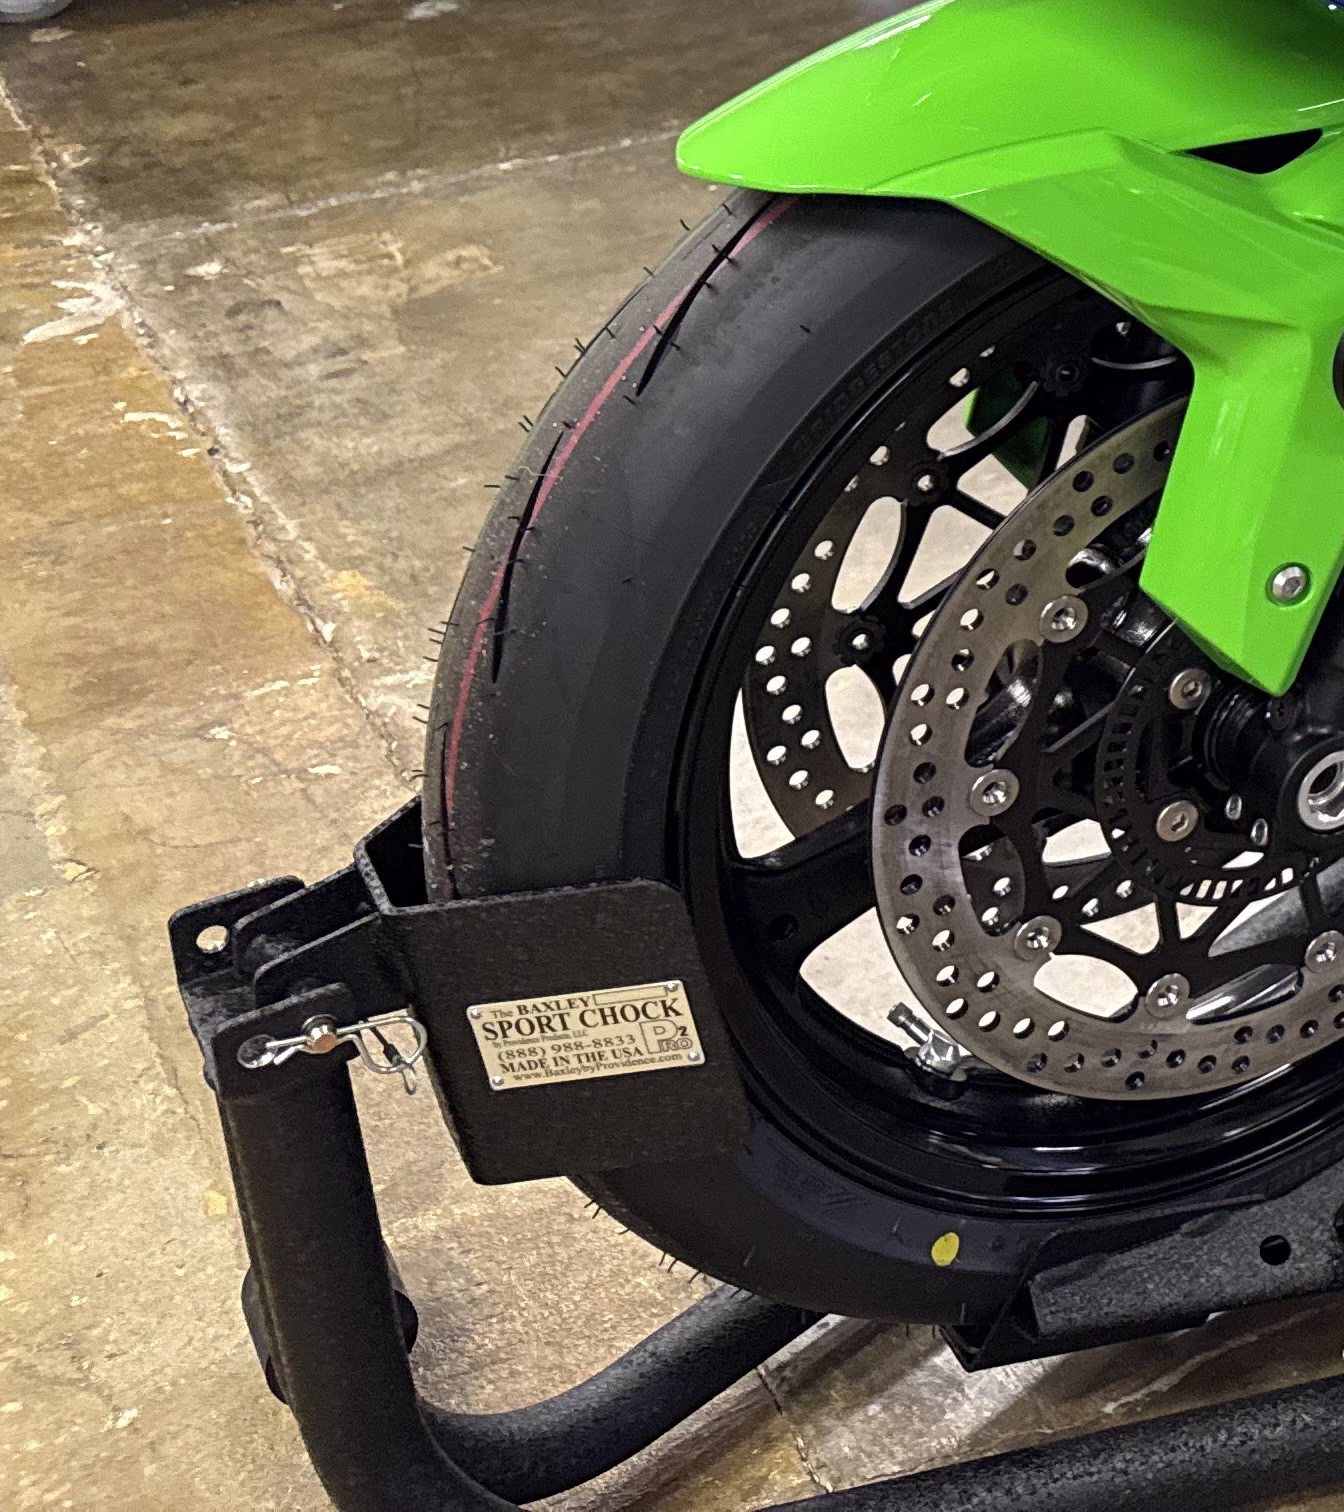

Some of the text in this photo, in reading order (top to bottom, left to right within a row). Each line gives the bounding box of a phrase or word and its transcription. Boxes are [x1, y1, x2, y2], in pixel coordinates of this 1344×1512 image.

[482, 998, 684, 1041] SPORT CHOCK
[490, 996, 591, 1019] The BAXLEY
[498, 1034, 636, 1062] (888) 988-8833
[501, 1046, 643, 1074] MADE IN THE USA
[513, 1053, 682, 1081] www.BaxleybyProvidence.com
